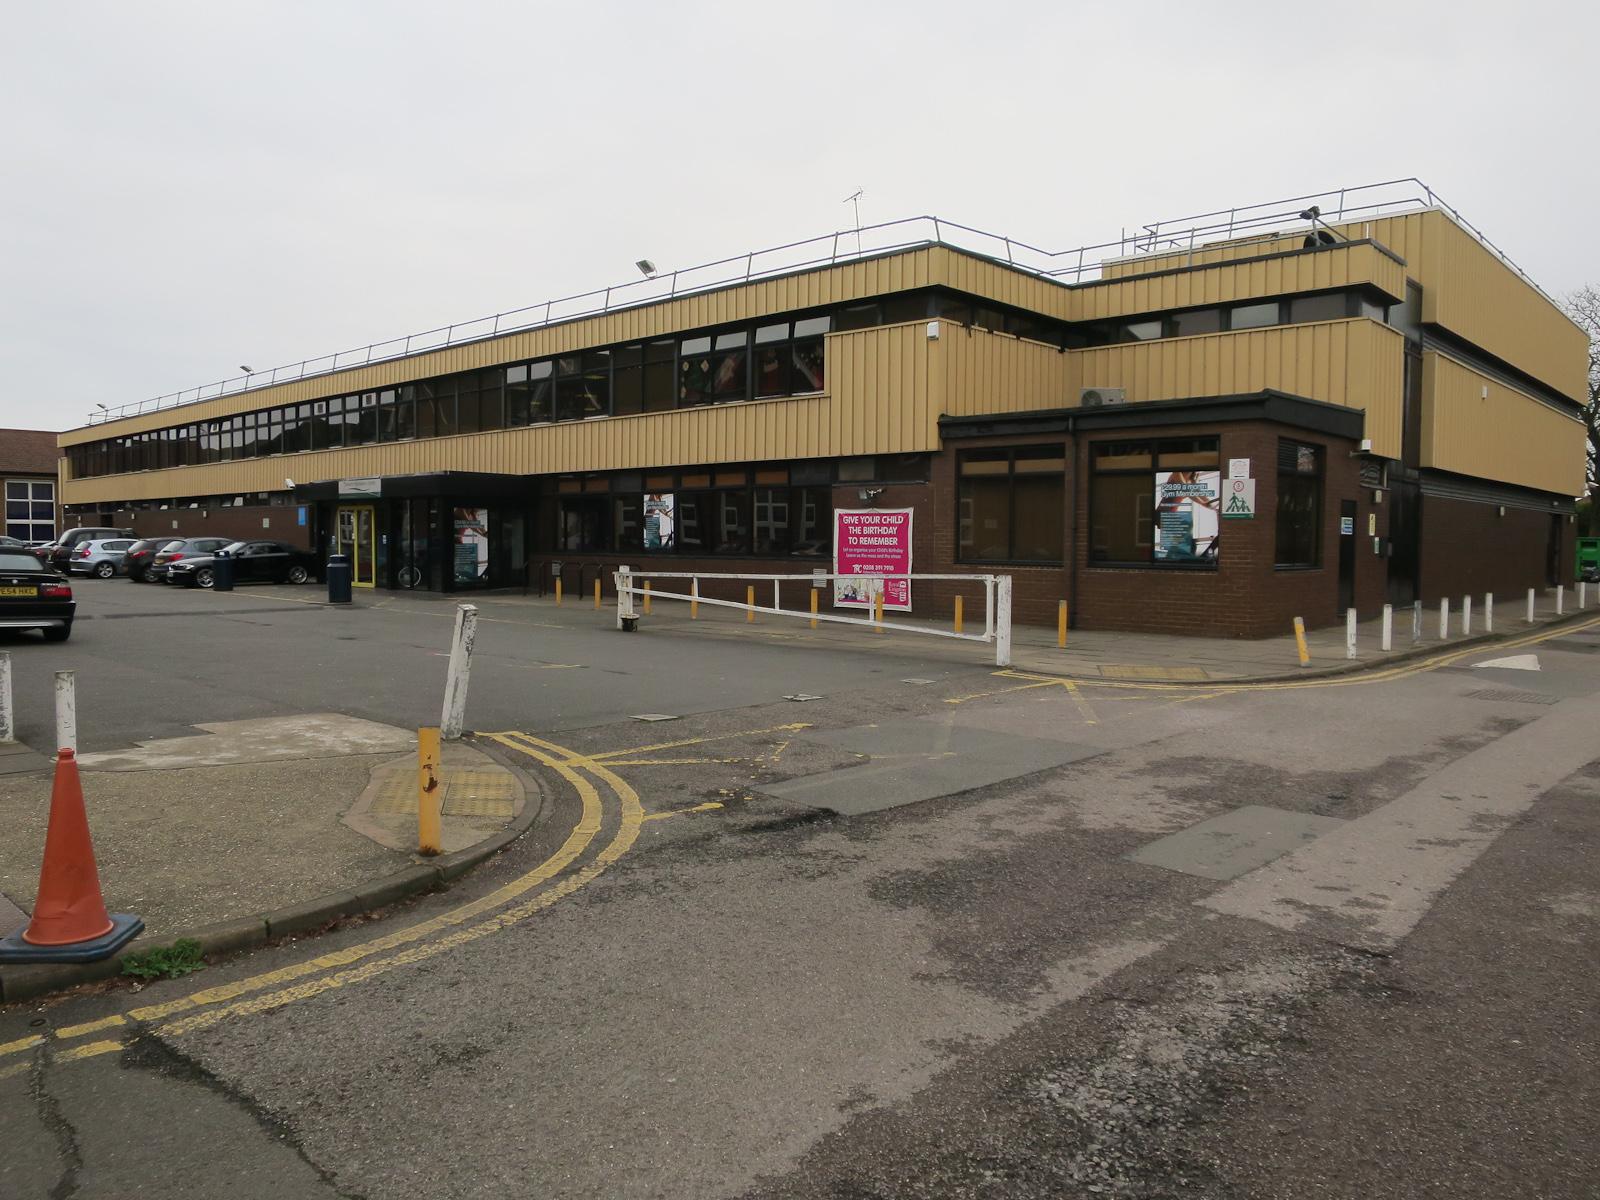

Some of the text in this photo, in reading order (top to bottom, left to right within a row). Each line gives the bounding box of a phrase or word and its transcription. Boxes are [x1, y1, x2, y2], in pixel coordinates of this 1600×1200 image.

[843, 516, 904, 524] GIVE YOUR CHILD
[848, 526, 898, 535] THE BIRTHDAY
[848, 537, 898, 545] TO REMEMBER
